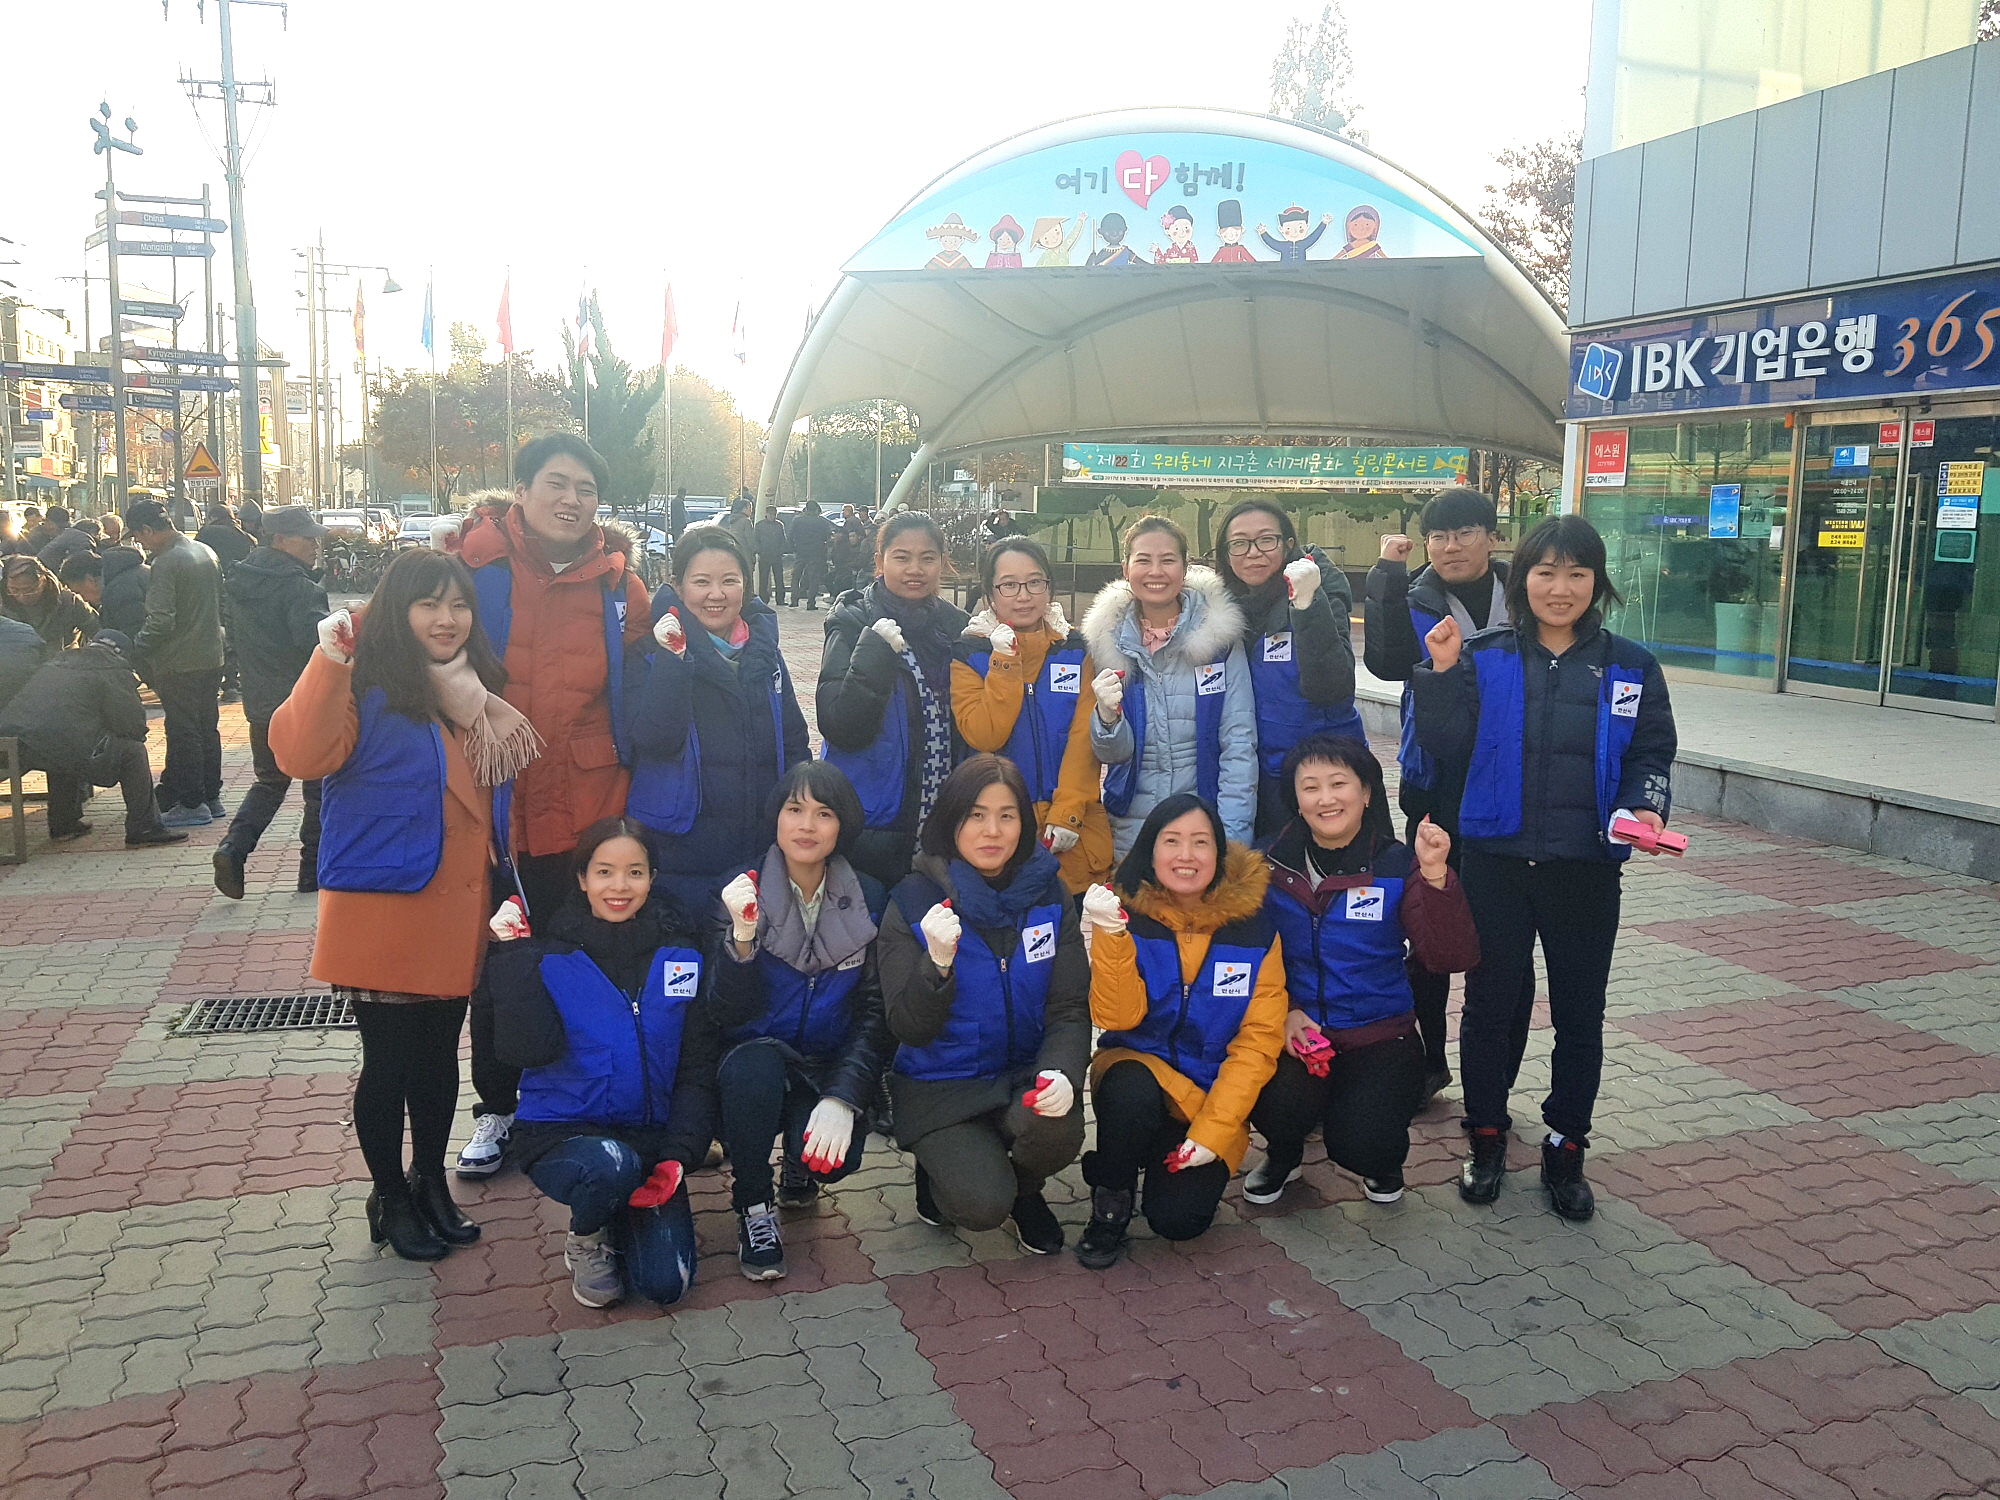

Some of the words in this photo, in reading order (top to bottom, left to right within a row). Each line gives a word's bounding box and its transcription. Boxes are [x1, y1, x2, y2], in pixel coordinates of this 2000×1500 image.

[1055, 167, 1108, 195] 여기
[1122, 161, 1159, 197] 다
[1174, 162, 1246, 197] 함께!
[143, 213, 165, 223] China
[140, 243, 173, 252] Mongolia
[1631, 337, 1706, 393] IBK
[1710, 314, 1878, 384] 기업은행
[1883, 289, 2000, 377] 365
[148, 350, 186, 359] Kyrgyzstan
[25, 364, 53, 373] Russia
[150, 375, 183, 384] Myanmar
[1595, 443, 1620, 458] 에스원
[1097, 449, 1146, 469] 제22회
[1151, 451, 1212, 472] 우리동네
[1217, 450, 1260, 473] 지구촌
[1266, 452, 1344, 474] 세계문화
[1351, 451, 1428, 476] 힐링콘서트
[1586, 475, 1608, 484] SECOM
